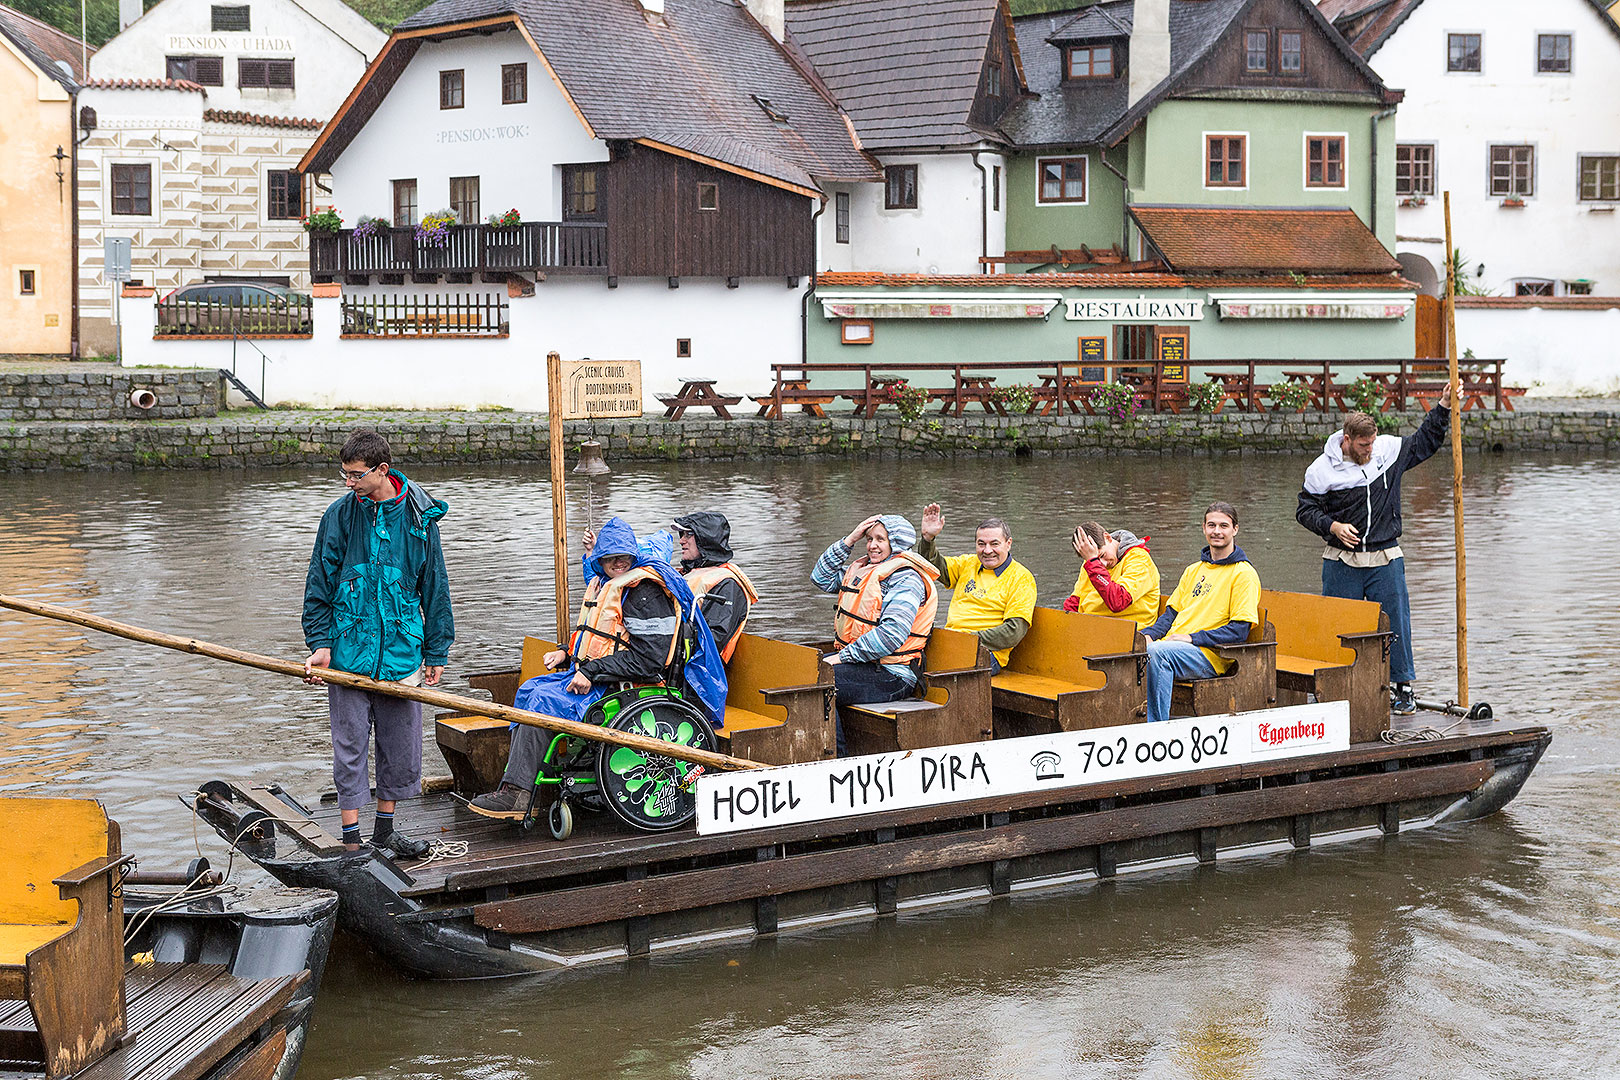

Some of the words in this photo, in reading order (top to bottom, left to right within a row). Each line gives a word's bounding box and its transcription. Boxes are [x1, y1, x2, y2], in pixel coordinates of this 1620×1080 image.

[170, 36, 228, 49] PENSION
[242, 37, 252, 50] U
[255, 38, 292, 51] HADA
[1073, 302, 1198, 318] RESTAURANT
[584, 366, 603, 379] SCENIC
[604, 366, 625, 379] CRUISES
[619, 399, 639, 412] PLAVBY
[1258, 719, 1325, 747] Eggenberg
[713, 779, 801, 823] HOTEL
[829, 755, 895, 808] MYŠÍ
[920, 751, 990, 794] DÍRA
[1077, 736, 1128, 774] 702
[1134, 738, 1184, 763] 000
[1190, 726, 1229, 764] 802
